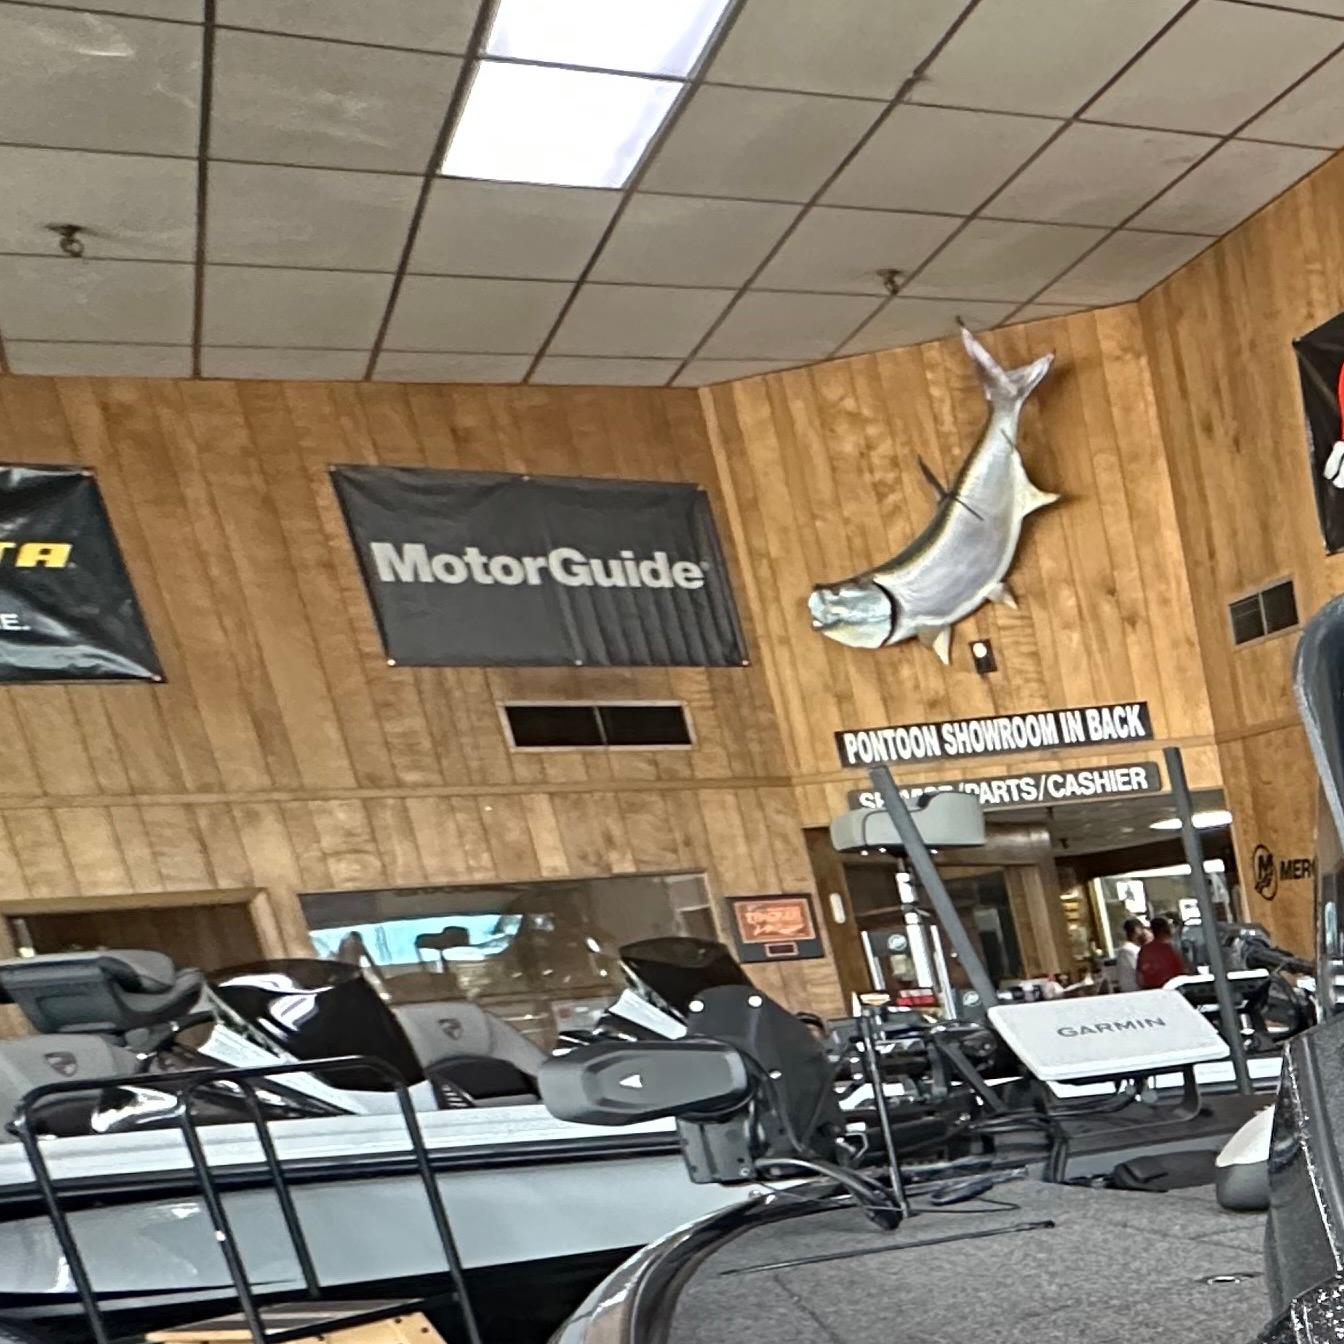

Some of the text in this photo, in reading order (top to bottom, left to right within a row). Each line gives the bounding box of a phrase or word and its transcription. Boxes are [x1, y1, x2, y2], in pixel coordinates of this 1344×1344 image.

[370, 541, 705, 589] MotorGuide
[843, 703, 1146, 764] PONTOON SHOWROOM IN BACK
[1056, 1017, 1166, 1038] GARMIN
